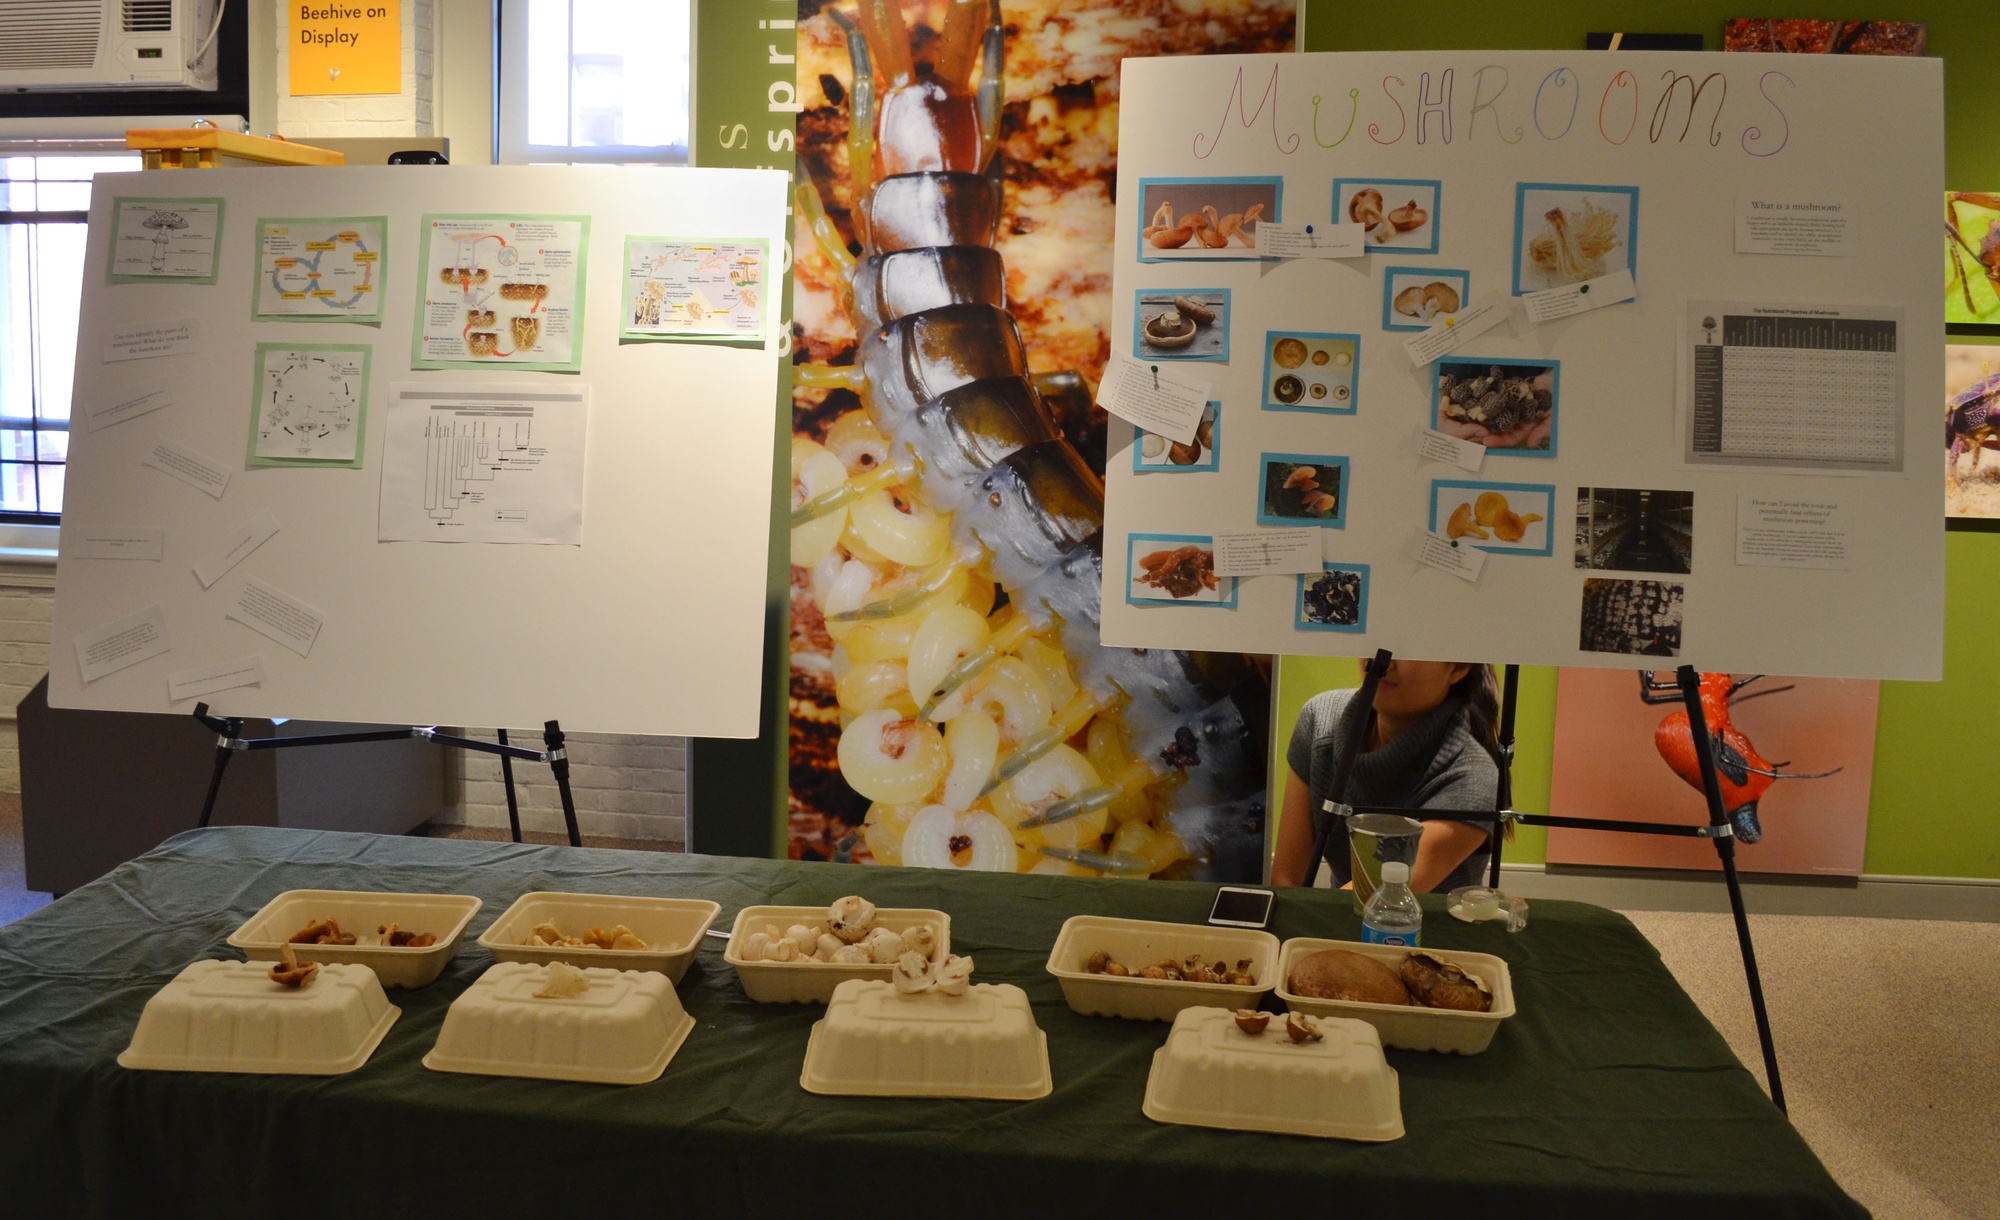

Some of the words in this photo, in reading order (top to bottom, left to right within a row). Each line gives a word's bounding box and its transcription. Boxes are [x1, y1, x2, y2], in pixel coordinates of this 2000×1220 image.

[301, 3, 361, 20] Beehive
[366, 7, 386, 18] on
[301, 27, 359, 48] Display
[1751, 201, 1773, 209] What
[1792, 203, 1841, 212] mushroom?
